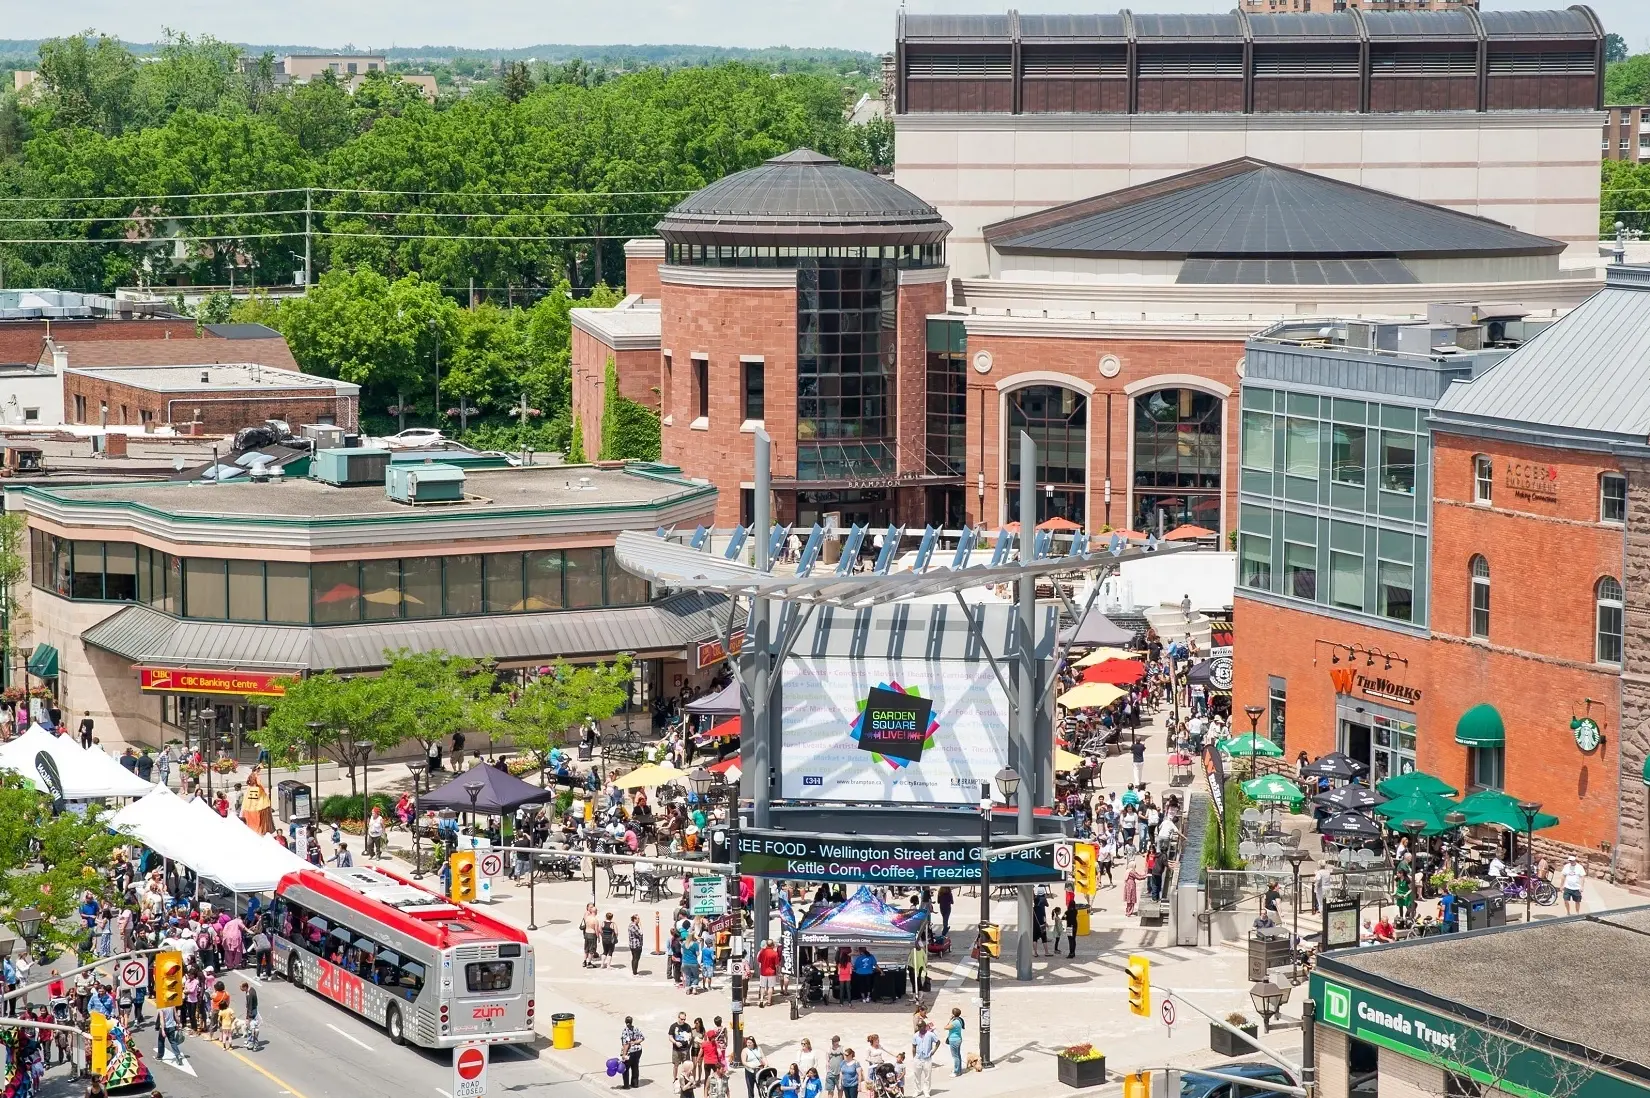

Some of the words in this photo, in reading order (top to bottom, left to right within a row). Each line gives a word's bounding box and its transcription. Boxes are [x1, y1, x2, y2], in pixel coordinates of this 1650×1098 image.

[152, 670, 170, 678] CIBC
[180, 676, 198, 686] CIBC
[200, 677, 230, 690] Banking
[232, 680, 258, 689] Centre
[872, 711, 916, 720] GARDEN
[872, 720, 916, 730] SQUARE
[882, 730, 906, 739] LIVE!
[900, 780, 938, 788] @CityBrampton
[765, 840, 807, 856] FOOD
[819, 844, 890, 862] Wellington
[894, 848, 935, 861] Street
[938, 848, 965, 861] and
[969, 848, 1006, 863] Gge
[1010, 846, 1042, 860] Park
[788, 860, 824, 874] Kettle
[829, 863, 865, 878] Corn,
[870, 865, 918, 880] Coffee,
[924, 866, 982, 878] Freezies
[712, 922, 724, 932] QUEEN
[725, 920, 730, 928] ST
[802, 934, 830, 942] Festivals
[782, 930, 792, 975] Festivals
[1327, 990, 1348, 1018] TD
[1358, 1001, 1412, 1035] Canada
[1414, 1020, 1457, 1052] Trust
[461, 1080, 480, 1089] ROAD
[457, 1086, 483, 1096] CLOSED
